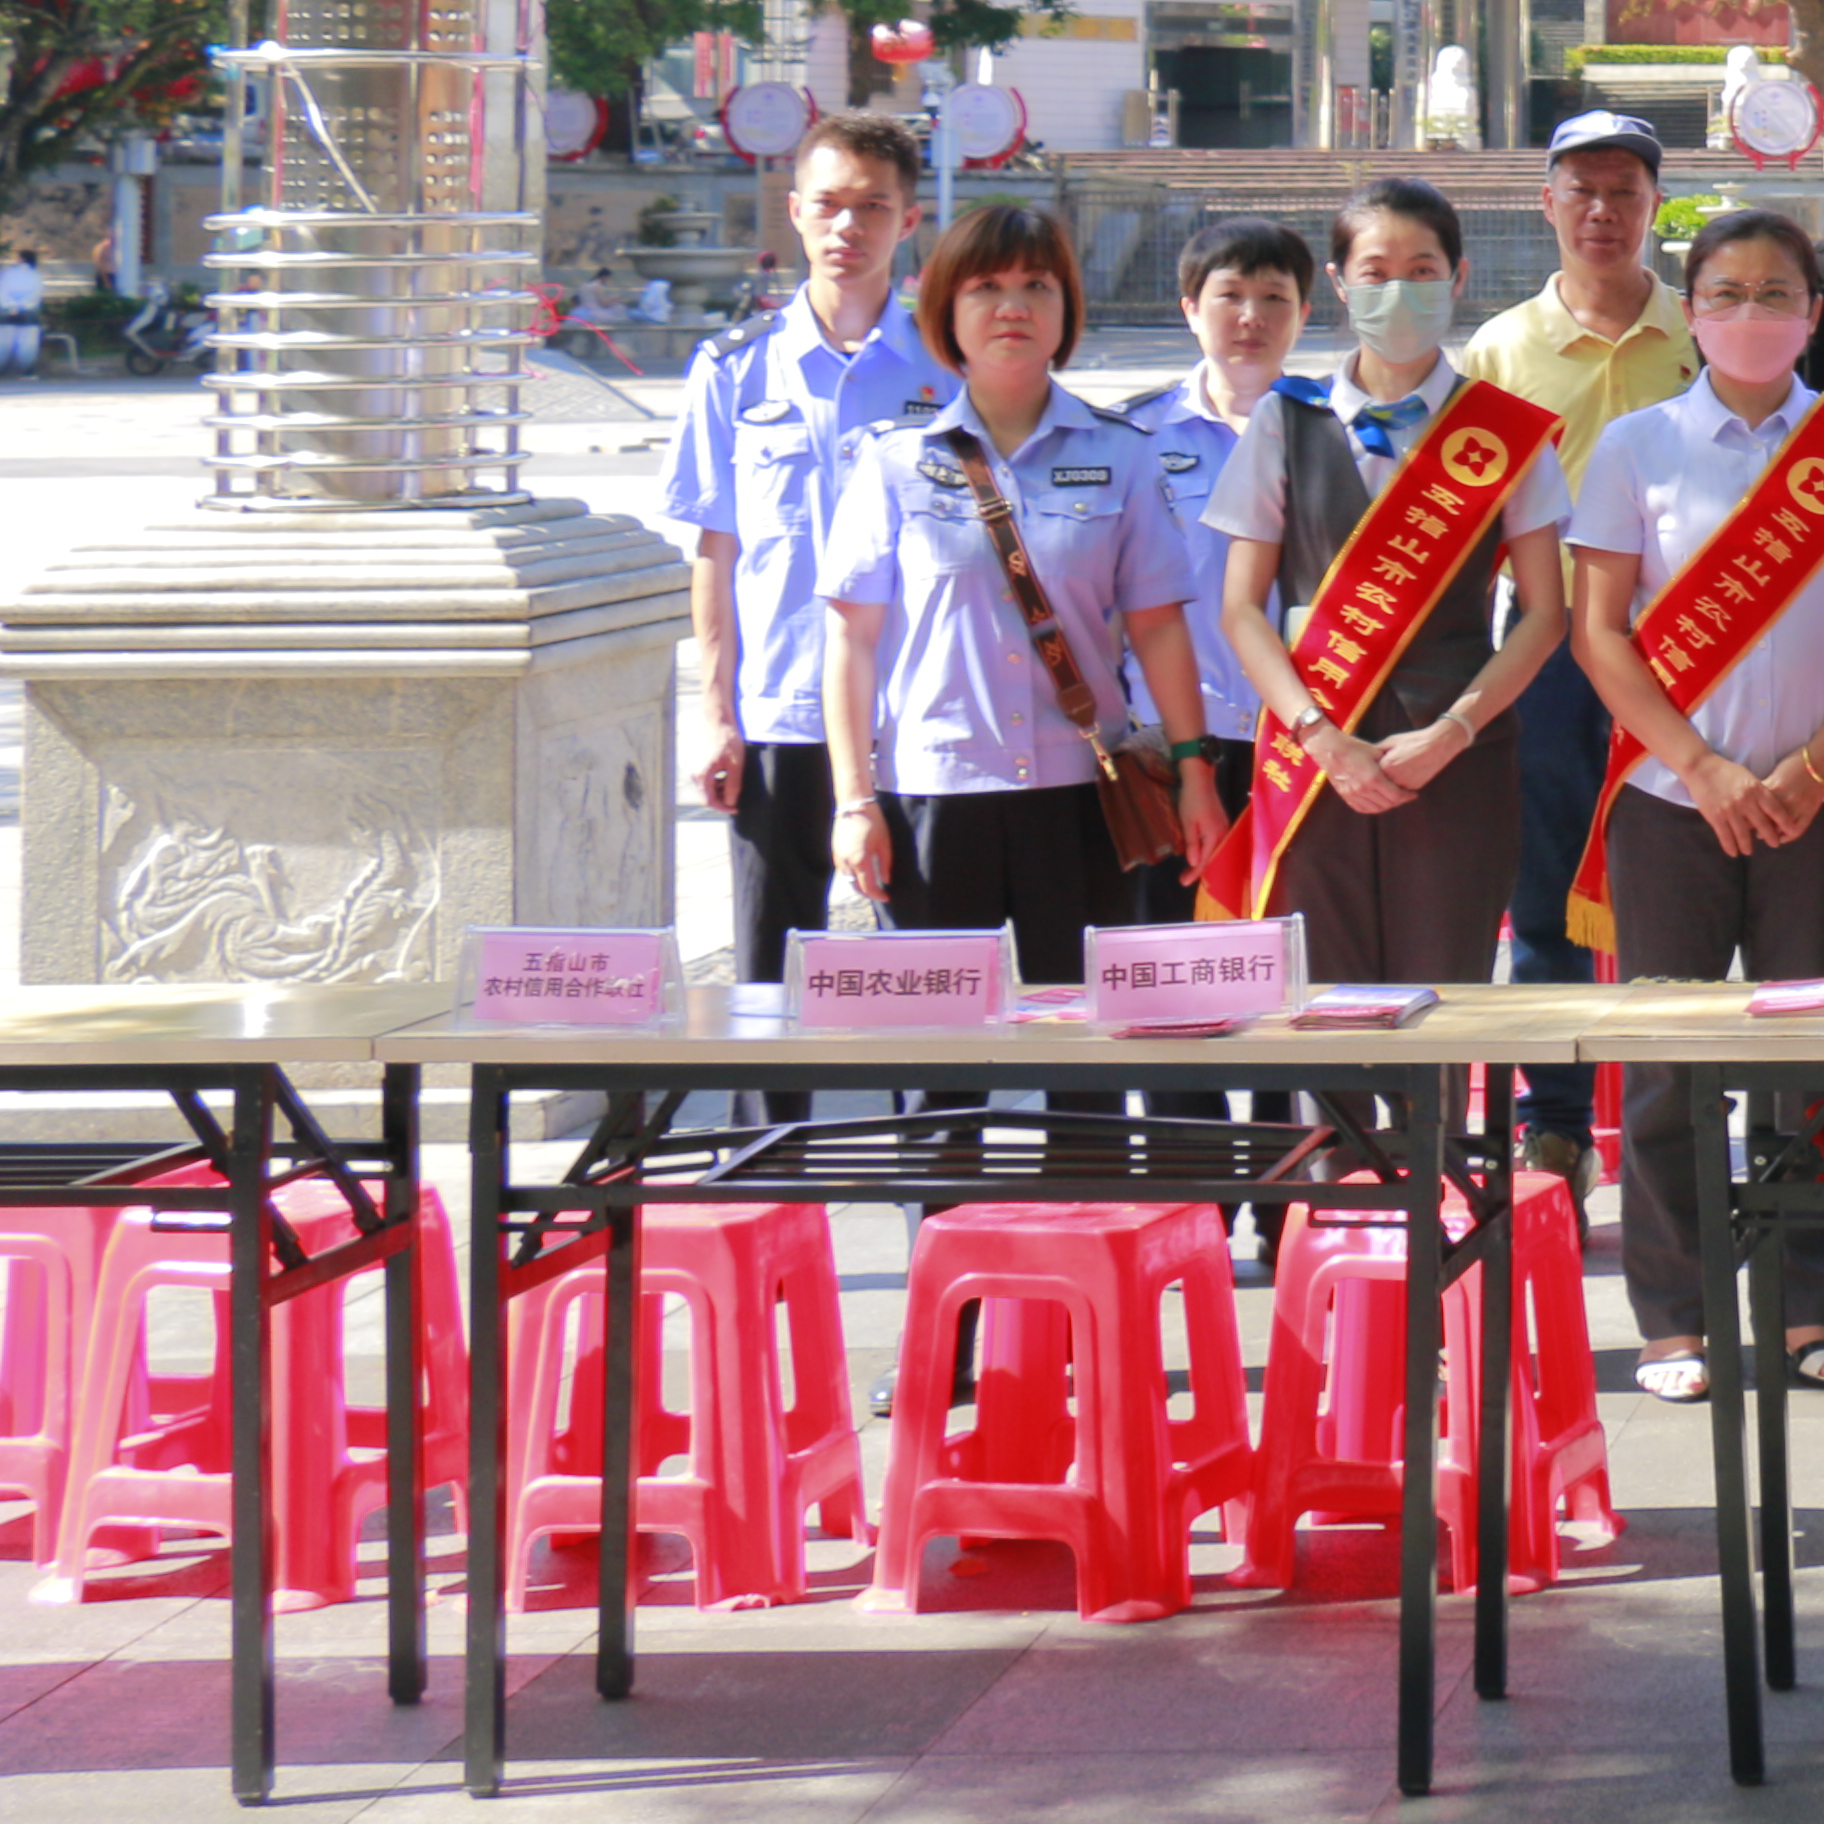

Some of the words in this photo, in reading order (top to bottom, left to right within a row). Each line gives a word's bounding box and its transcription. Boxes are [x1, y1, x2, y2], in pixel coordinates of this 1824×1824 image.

[523, 952, 610, 973] 五指山市
[1102, 954, 1277, 991] 中国工商银行
[483, 977, 646, 1000] 农村信用合作联社
[808, 969, 983, 998] 中国农业银行
